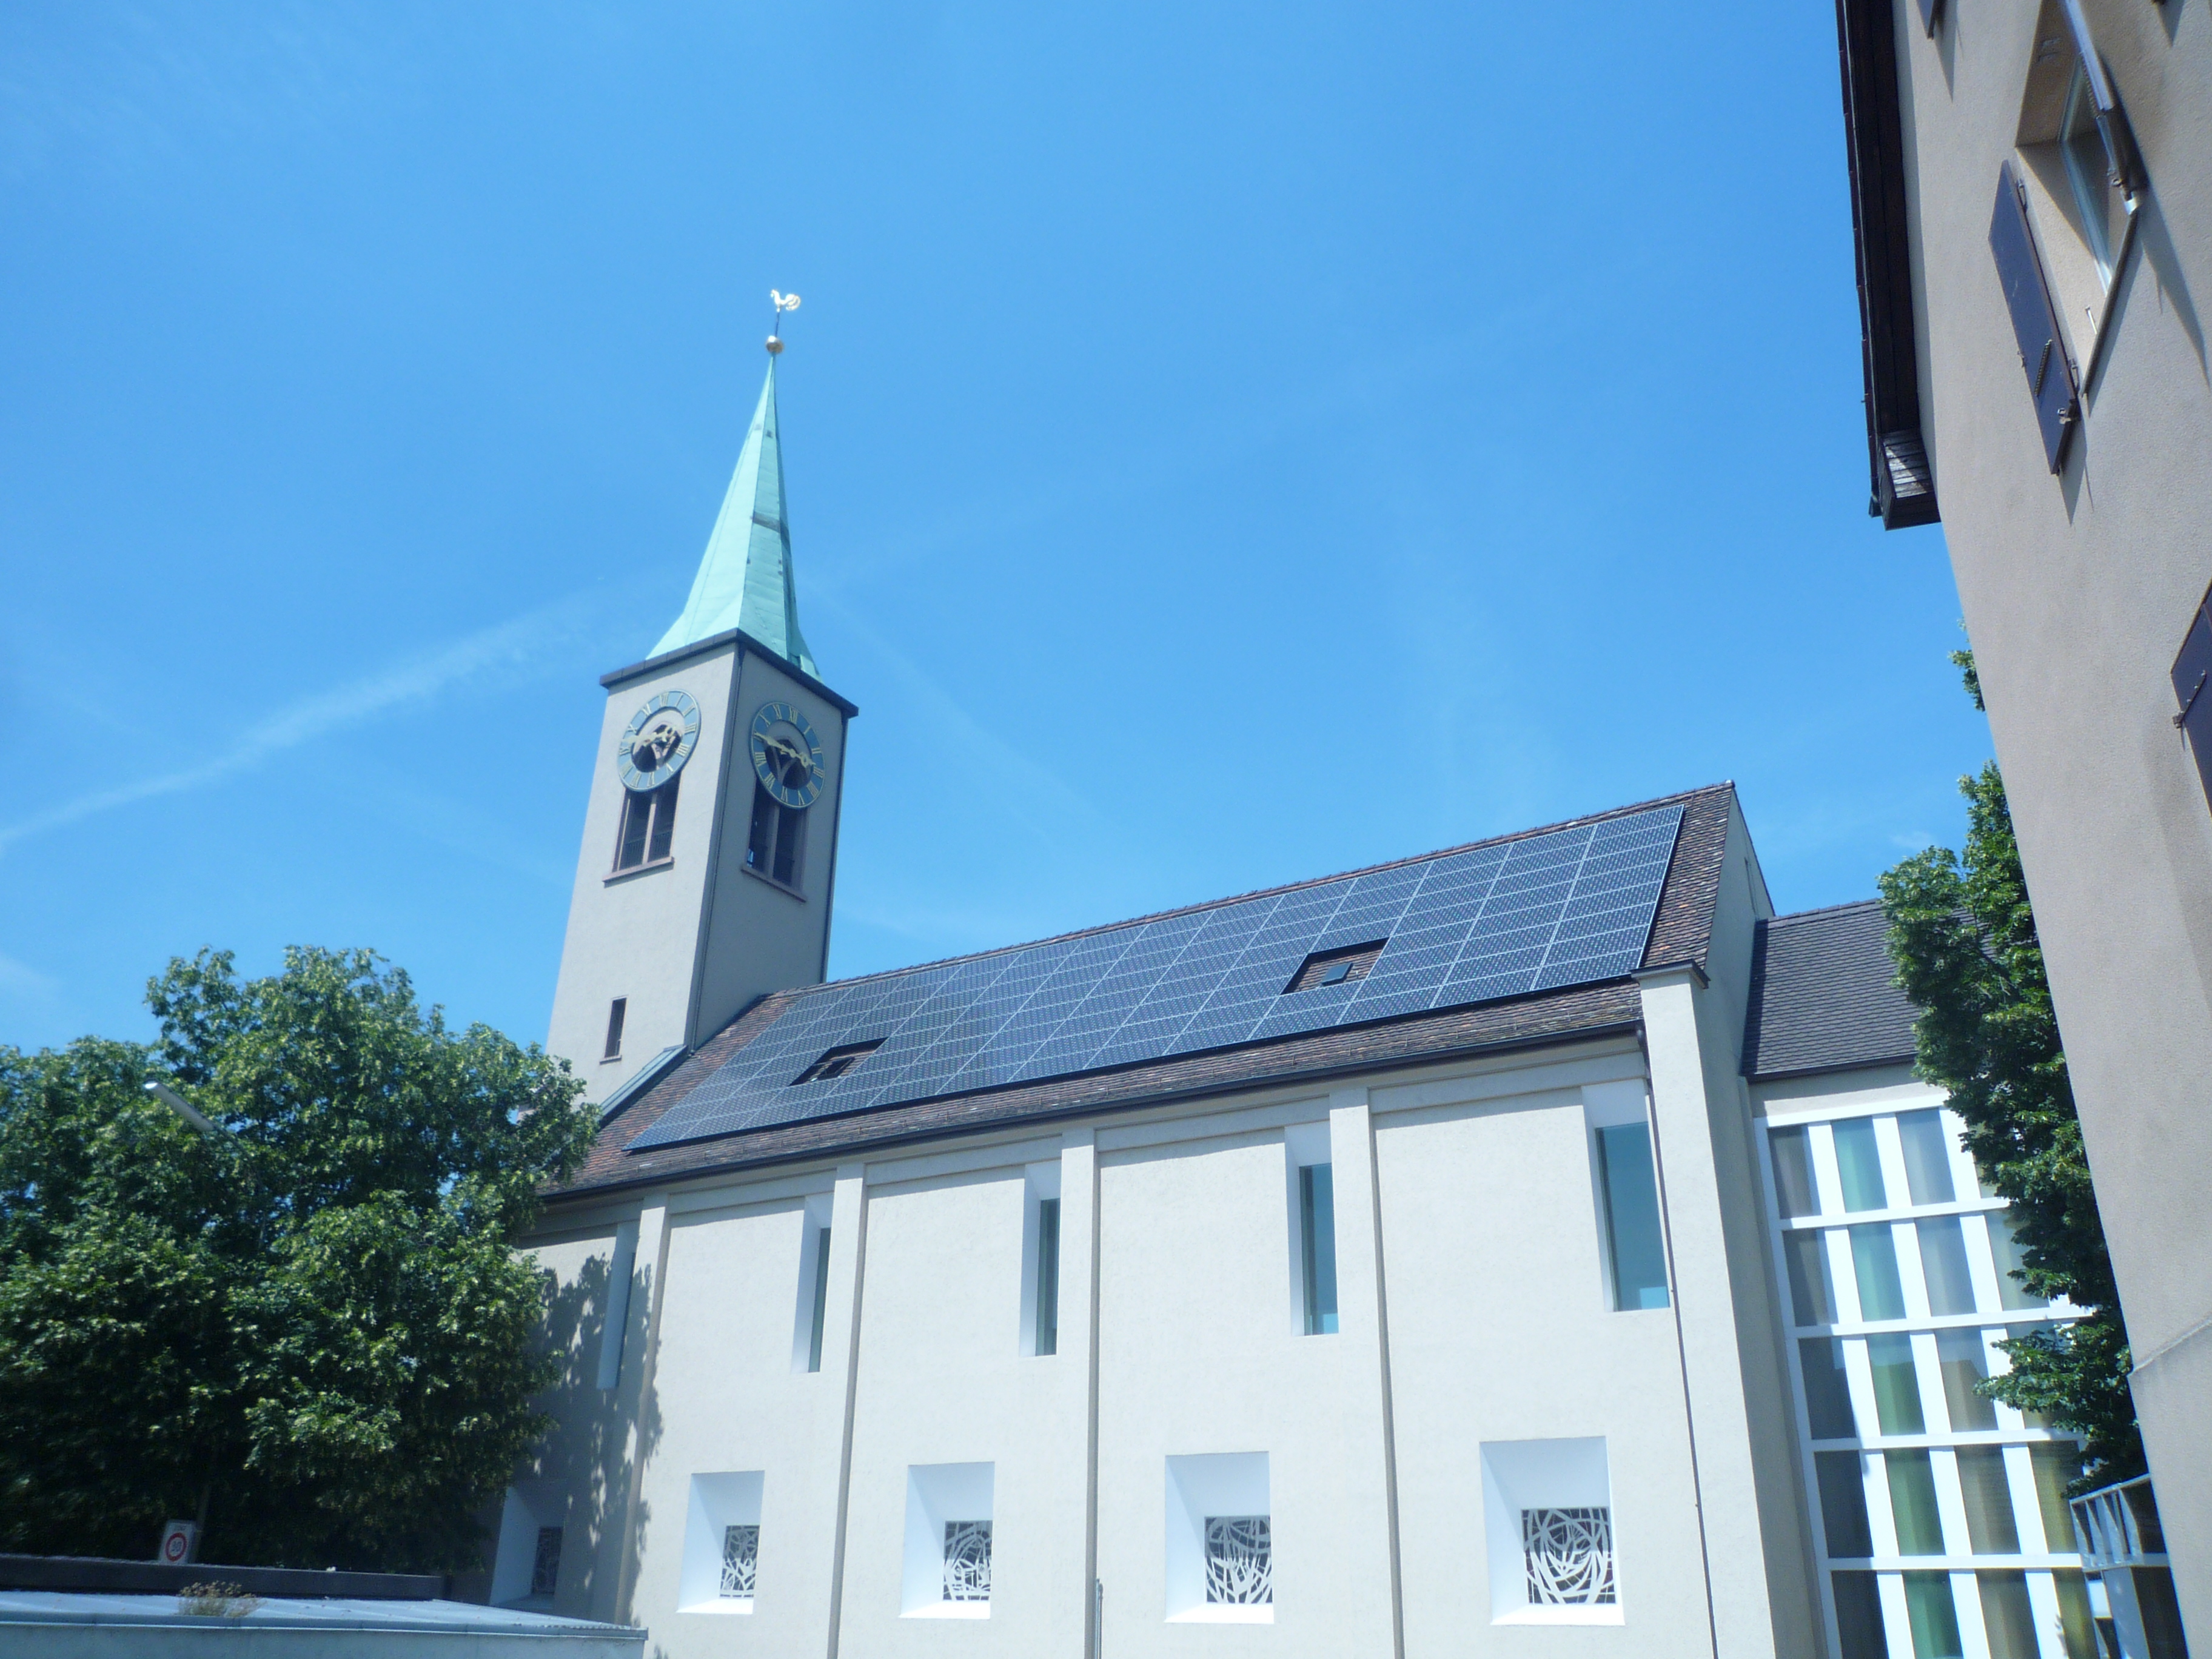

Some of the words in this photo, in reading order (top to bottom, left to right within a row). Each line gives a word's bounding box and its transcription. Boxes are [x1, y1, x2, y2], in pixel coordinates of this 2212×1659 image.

[773, 704, 782, 720] XI
[789, 707, 798, 724] XII
[685, 723, 697, 734] III
[803, 725, 811, 734] I
[675, 743, 690, 757] IIII
[755, 752, 766, 766] VIII
[813, 766, 824, 778] III
[765, 772, 776, 789] VII
[781, 786, 788, 802] VI
[798, 789, 805, 805] V
